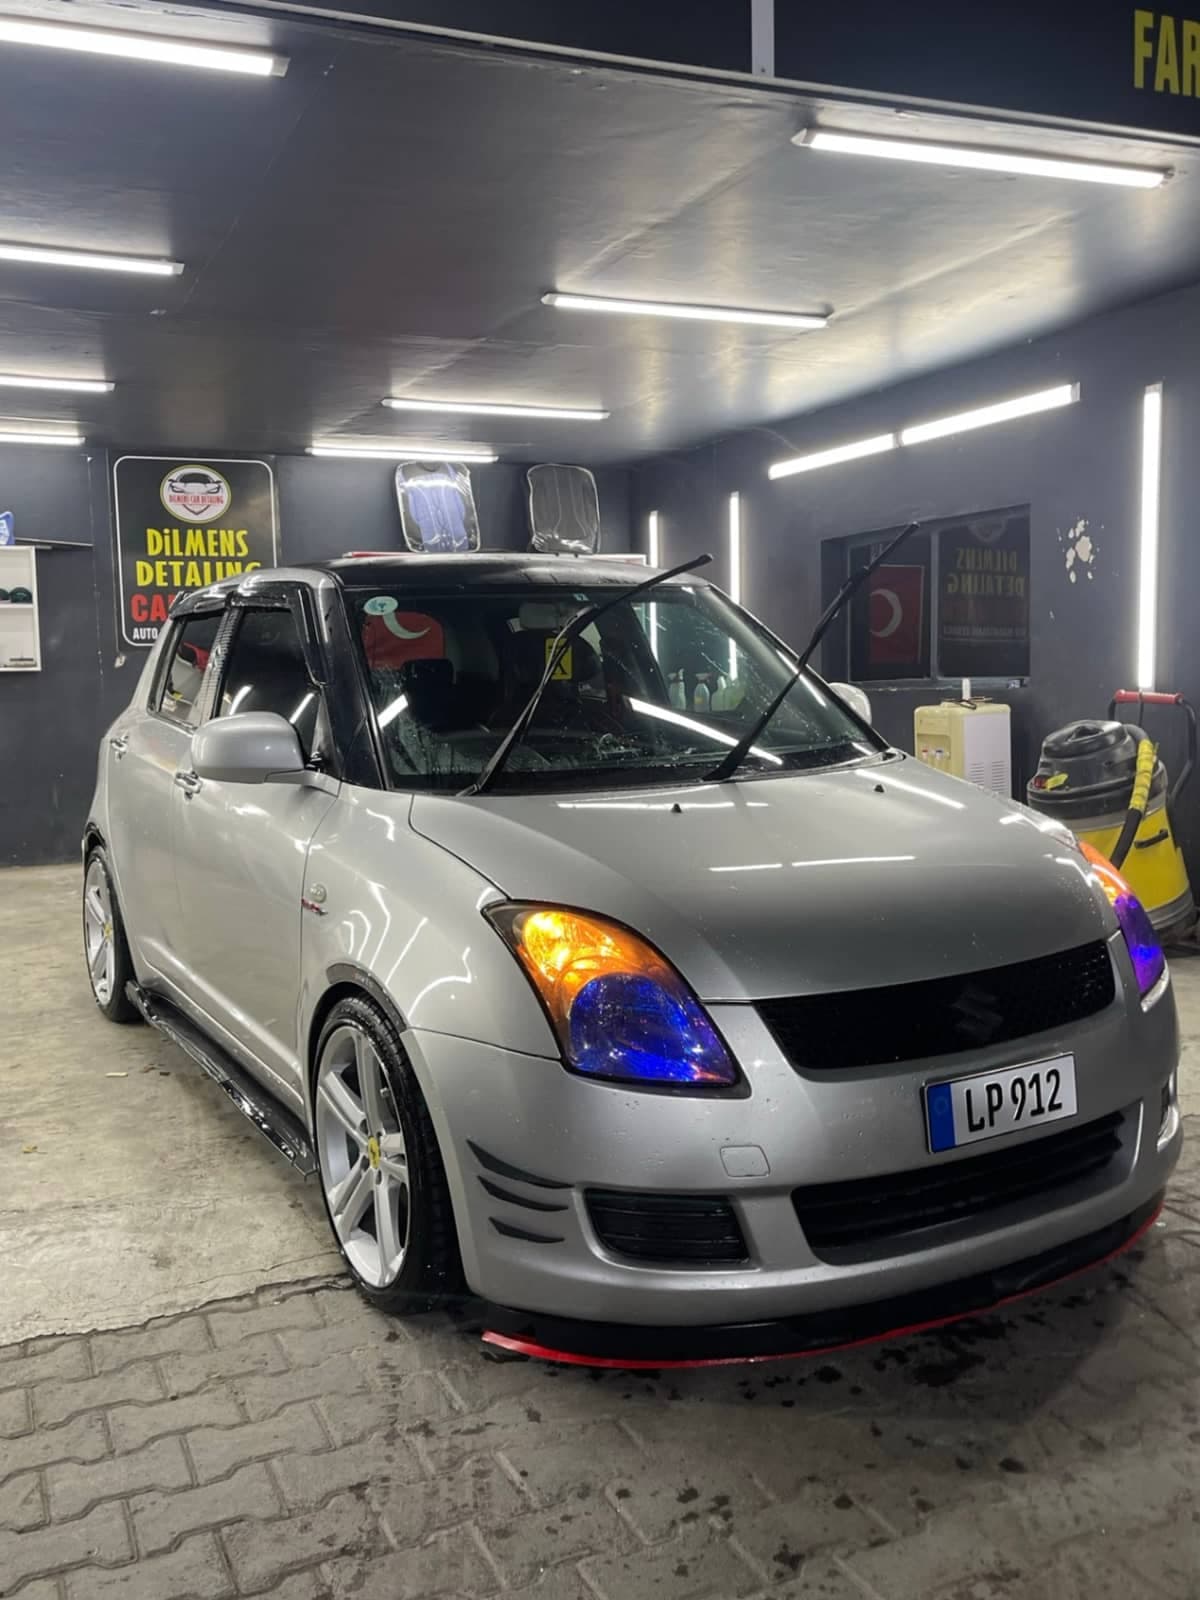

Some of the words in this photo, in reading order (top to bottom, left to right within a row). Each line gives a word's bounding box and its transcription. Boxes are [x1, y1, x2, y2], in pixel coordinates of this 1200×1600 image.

[1133, 9, 1200, 99] FAR
[130, 593, 177, 623] CA
[132, 627, 158, 640] AUTO
[965, 1083, 1003, 1132] LP
[1010, 1069, 1062, 1121] 912
